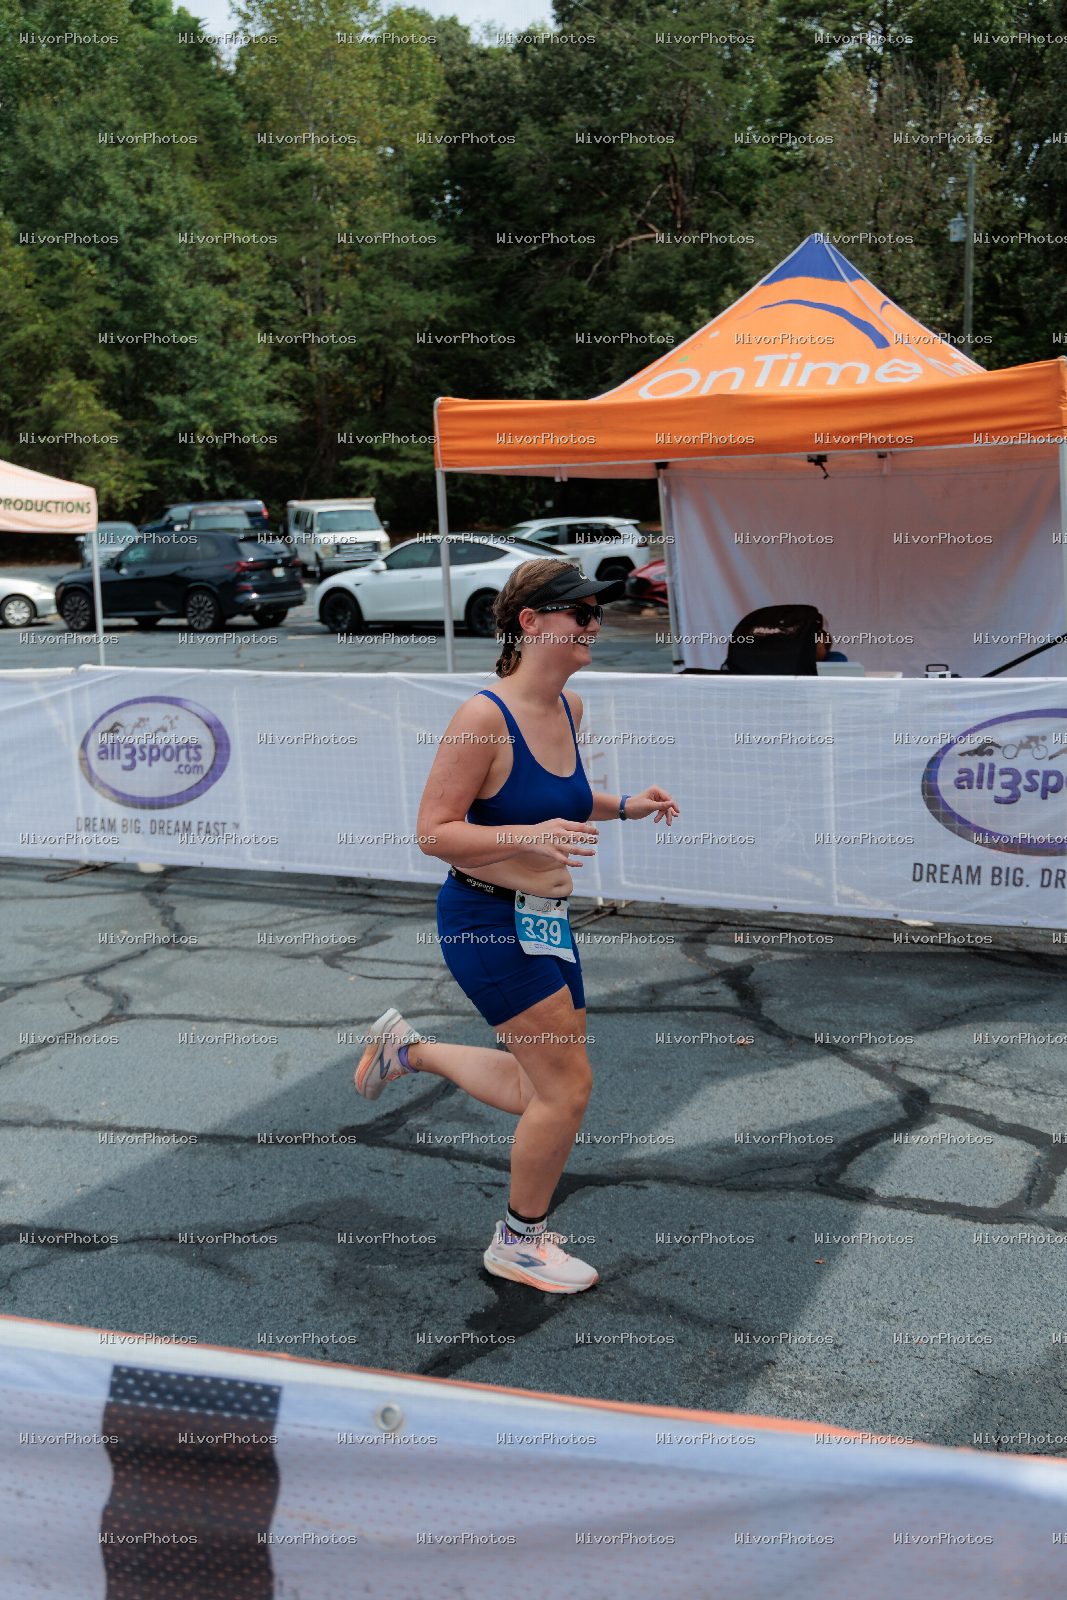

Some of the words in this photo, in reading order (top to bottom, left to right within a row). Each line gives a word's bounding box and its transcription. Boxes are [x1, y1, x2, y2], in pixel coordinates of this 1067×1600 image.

[97, 739, 203, 771] all3sports
[954, 762, 1067, 805] all3sp
[76, 816, 117, 834] DREAM
[150, 819, 192, 837] DREAM
[912, 862, 982, 886] DREAM
[991, 866, 1030, 888] BIG.
